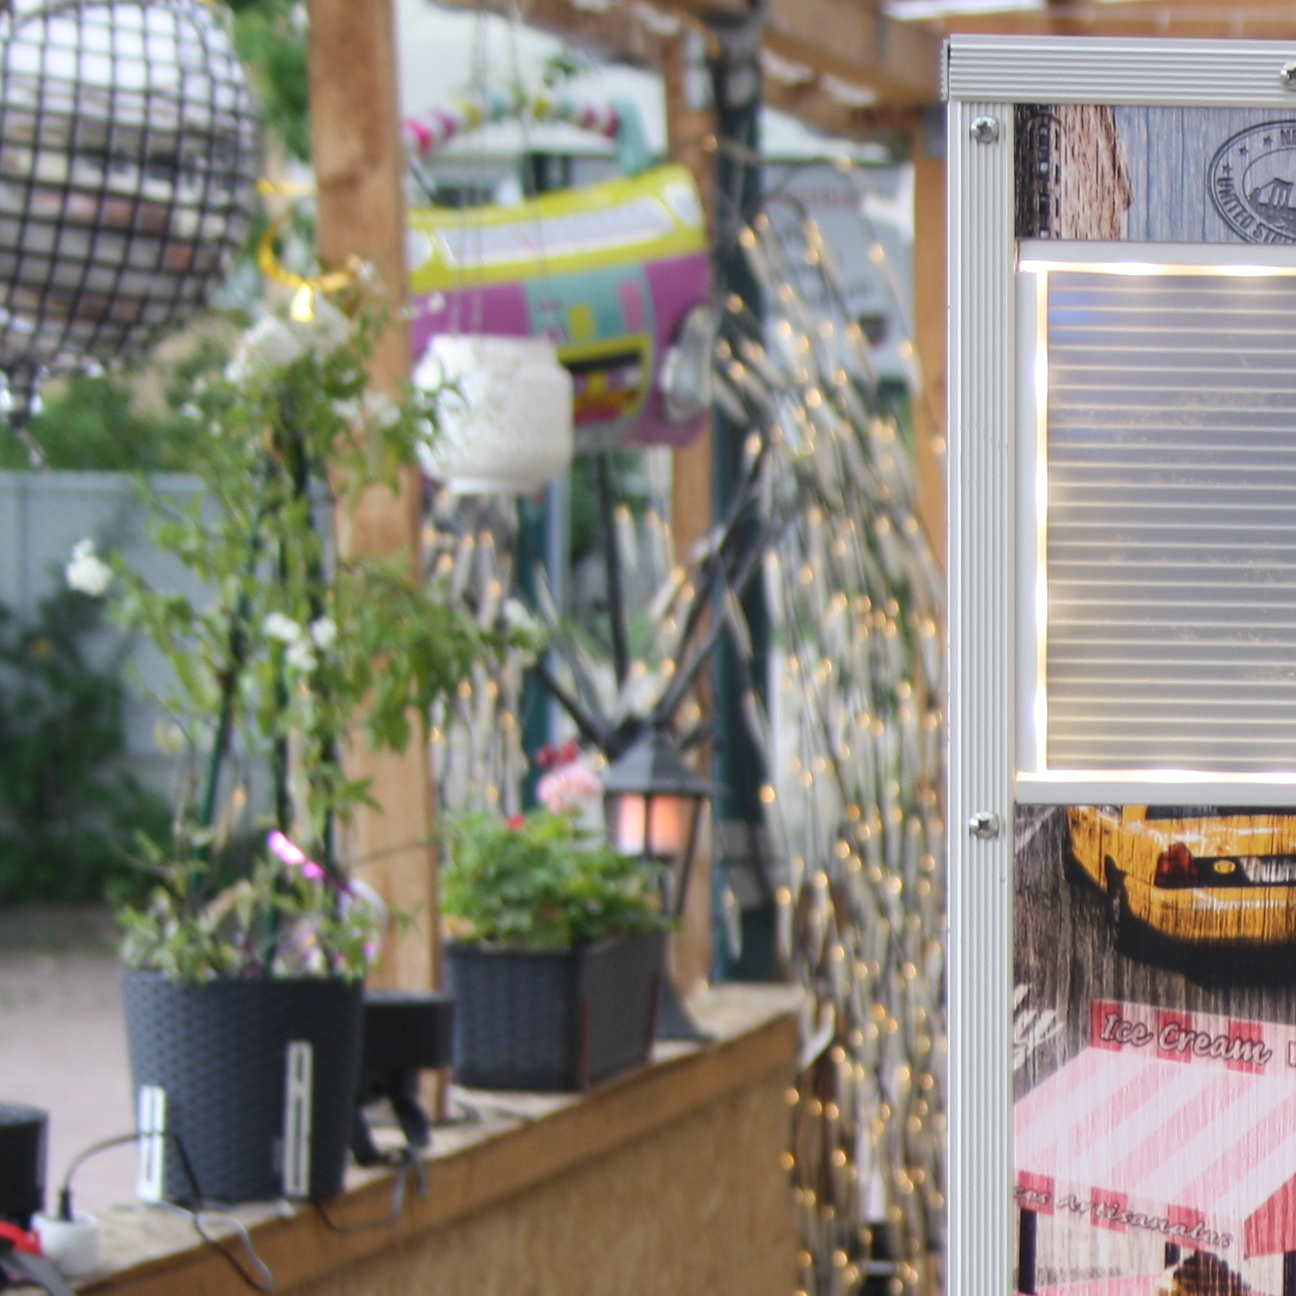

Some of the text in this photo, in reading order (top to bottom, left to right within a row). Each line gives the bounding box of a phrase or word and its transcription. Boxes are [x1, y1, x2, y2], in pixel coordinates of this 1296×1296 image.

[1216, 177, 1256, 230] UNITED
[1100, 1011, 1154, 1046] Ice
[1157, 1022, 1275, 1066] Cream
